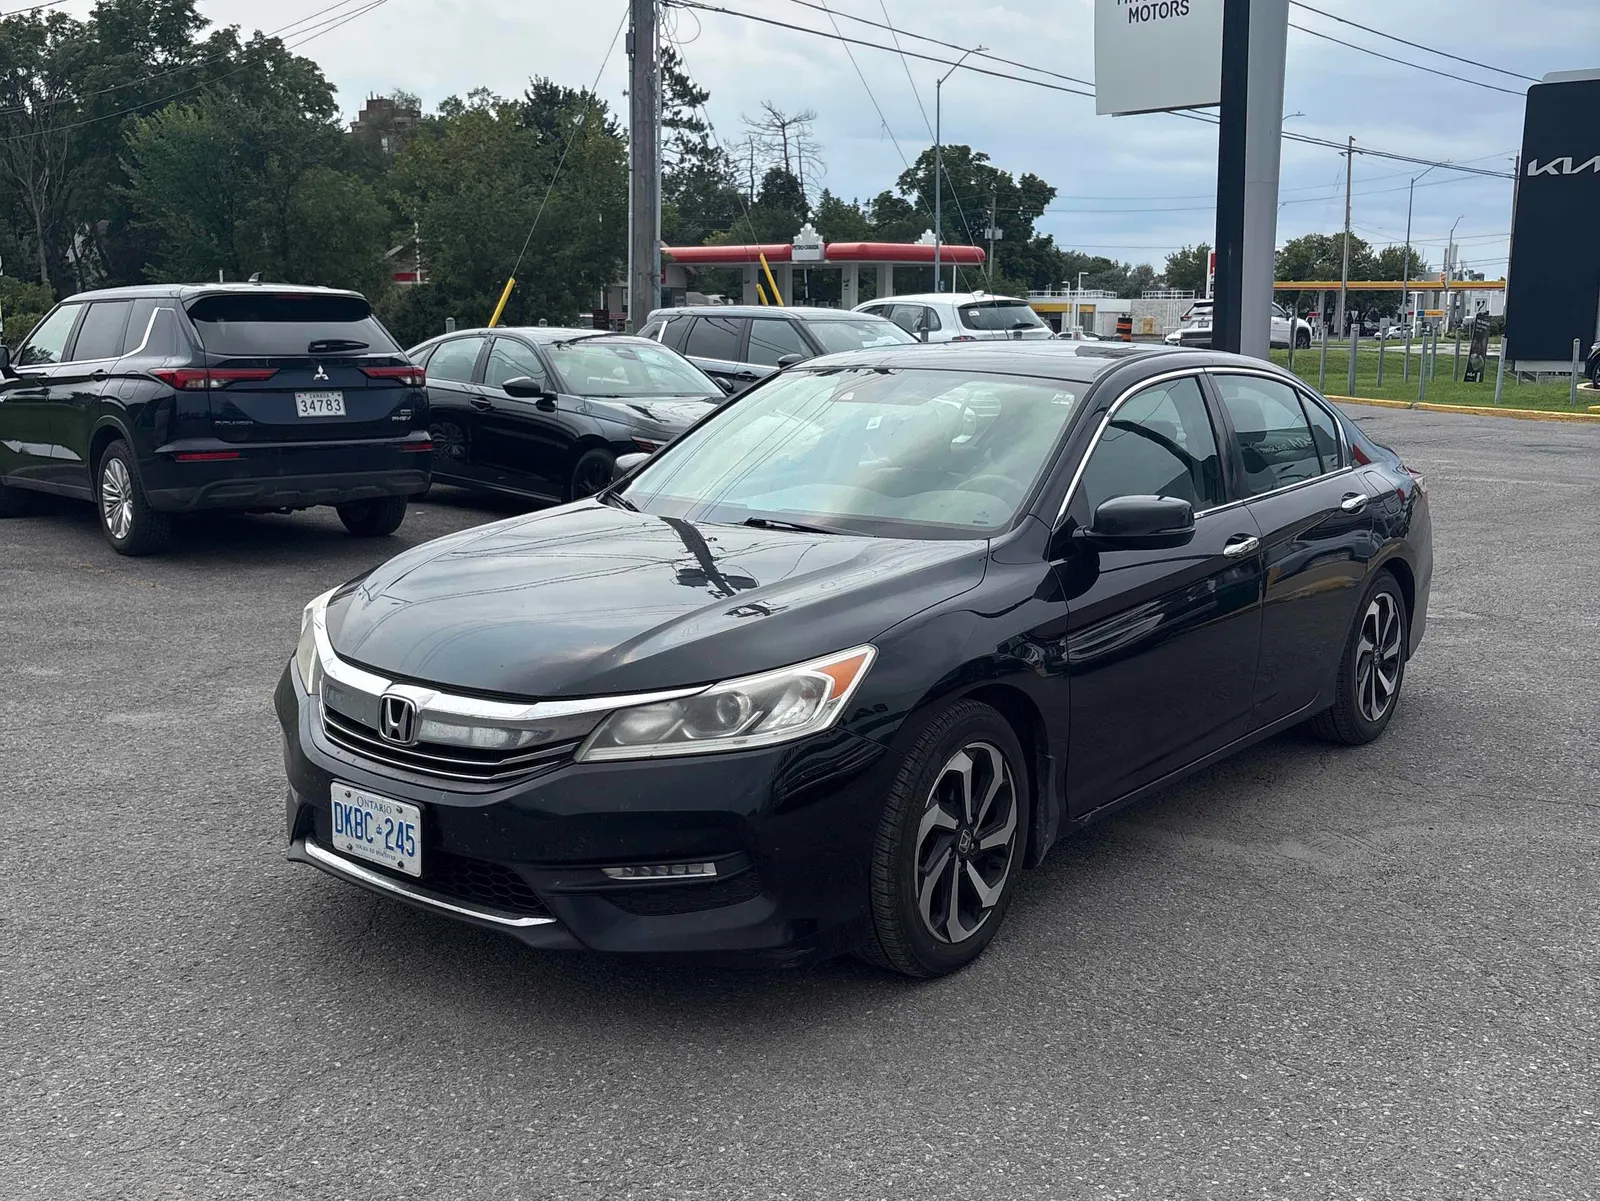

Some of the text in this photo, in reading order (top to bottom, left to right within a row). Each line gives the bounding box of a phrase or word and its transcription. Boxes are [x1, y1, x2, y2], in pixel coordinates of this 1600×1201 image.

[1128, 0, 1190, 24] MOTORS
[300, 399, 341, 412] 34783
[334, 801, 415, 857] DKBC 245
